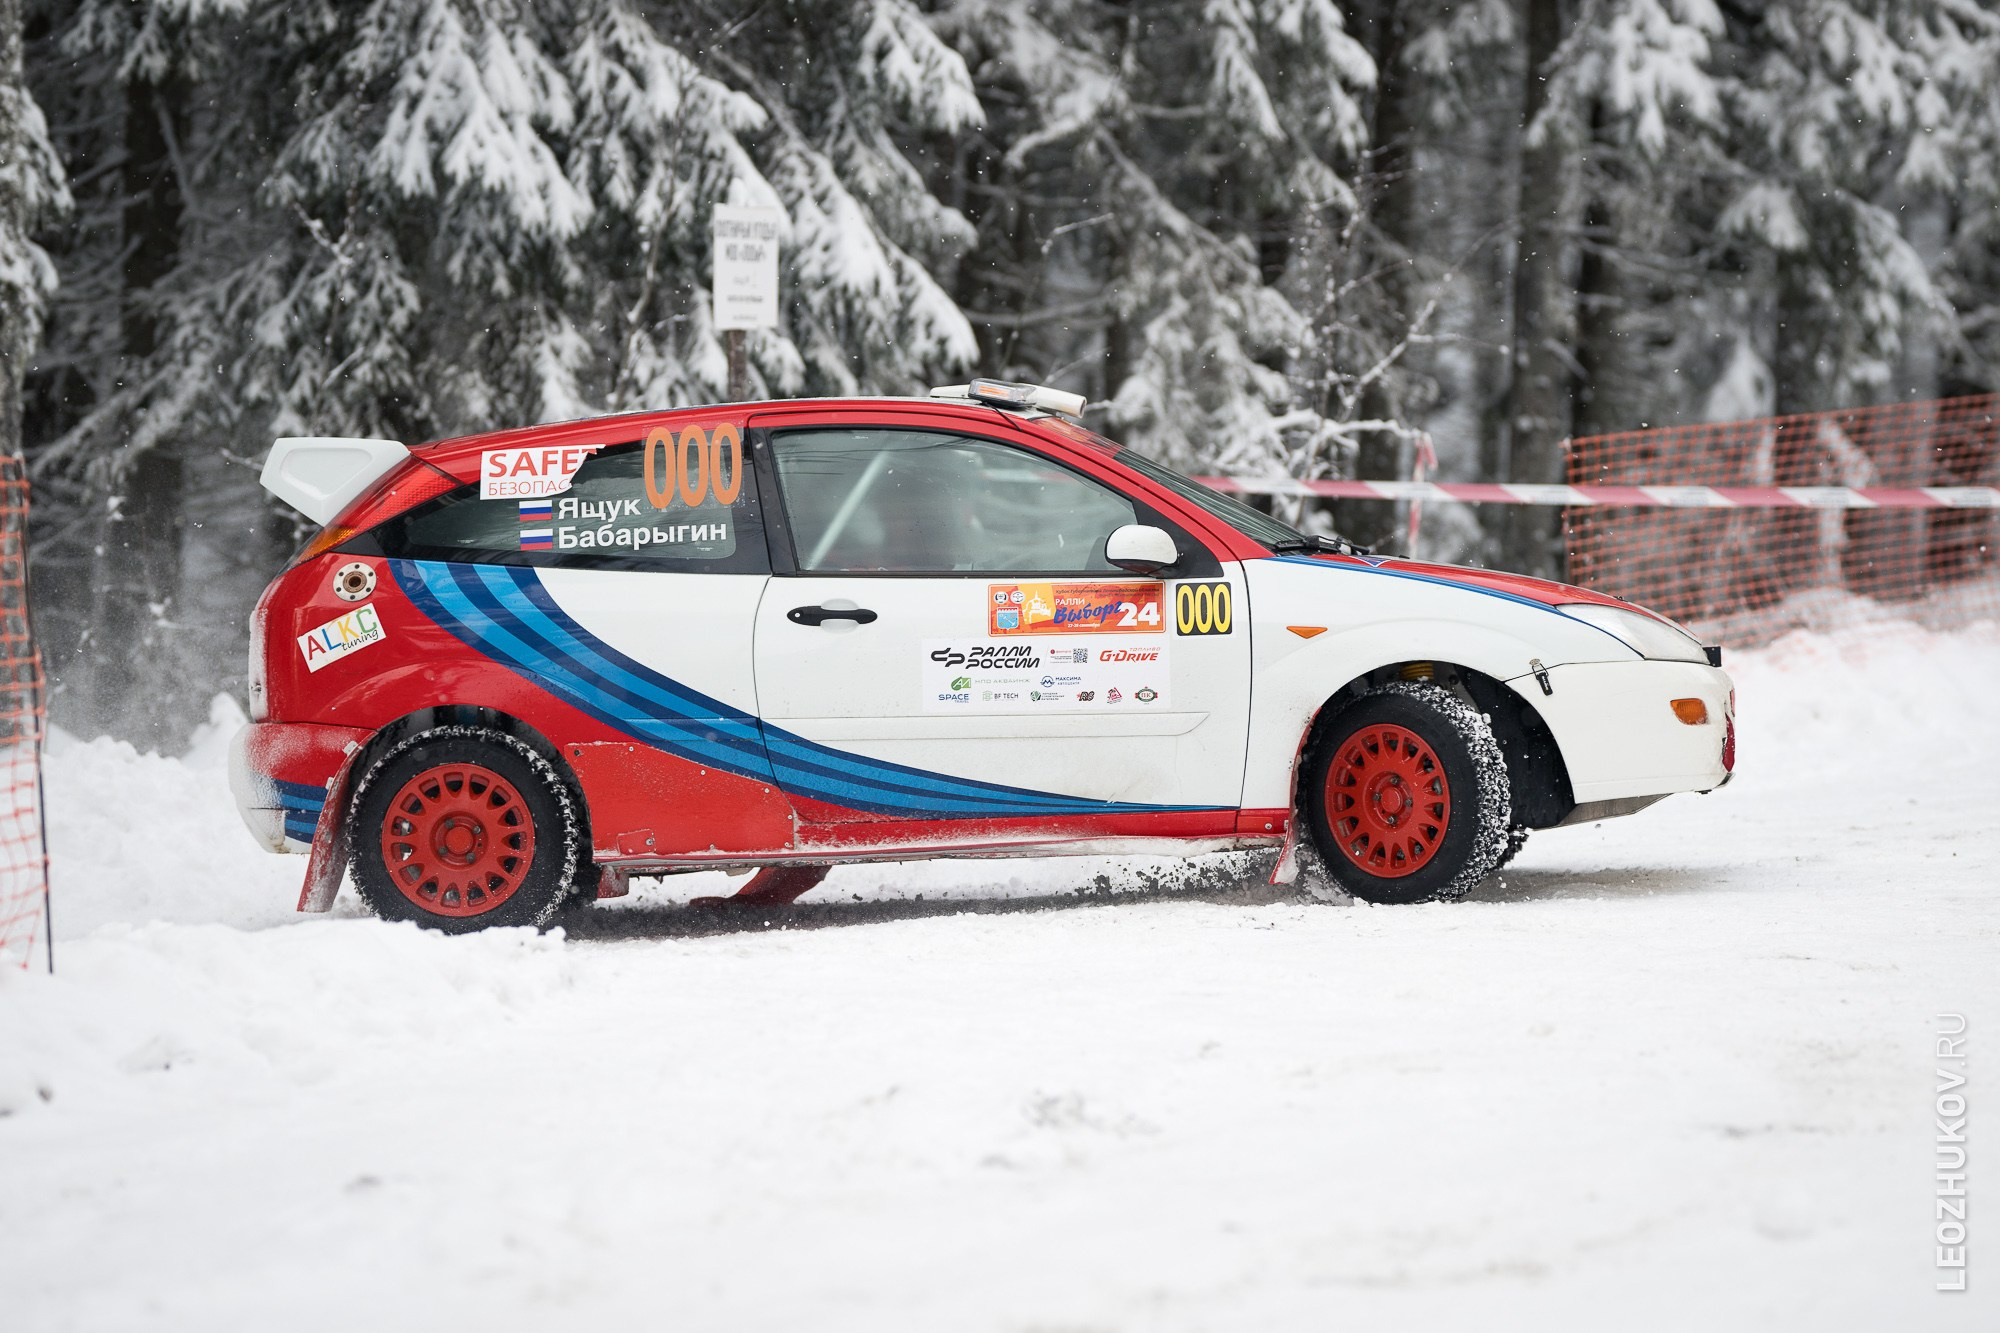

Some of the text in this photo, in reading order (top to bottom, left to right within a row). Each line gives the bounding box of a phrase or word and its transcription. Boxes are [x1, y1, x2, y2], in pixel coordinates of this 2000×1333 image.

[488, 448, 598, 478] SAFE
[644, 422, 742, 509] 000
[558, 497, 642, 523] Ящук
[558, 523, 728, 551] Бабарыгин
[1054, 601, 1161, 627] Выборг 24
[1056, 598, 1085, 606] РАЛЛИ
[1177, 583, 1231, 634] 000
[307, 608, 378, 661] ALKC
[342, 629, 379, 651] tuning
[965, 658, 1041, 670] РОССИИ
[970, 646, 1032, 657] РАЛЛИ
[938, 693, 970, 701] SPACE
